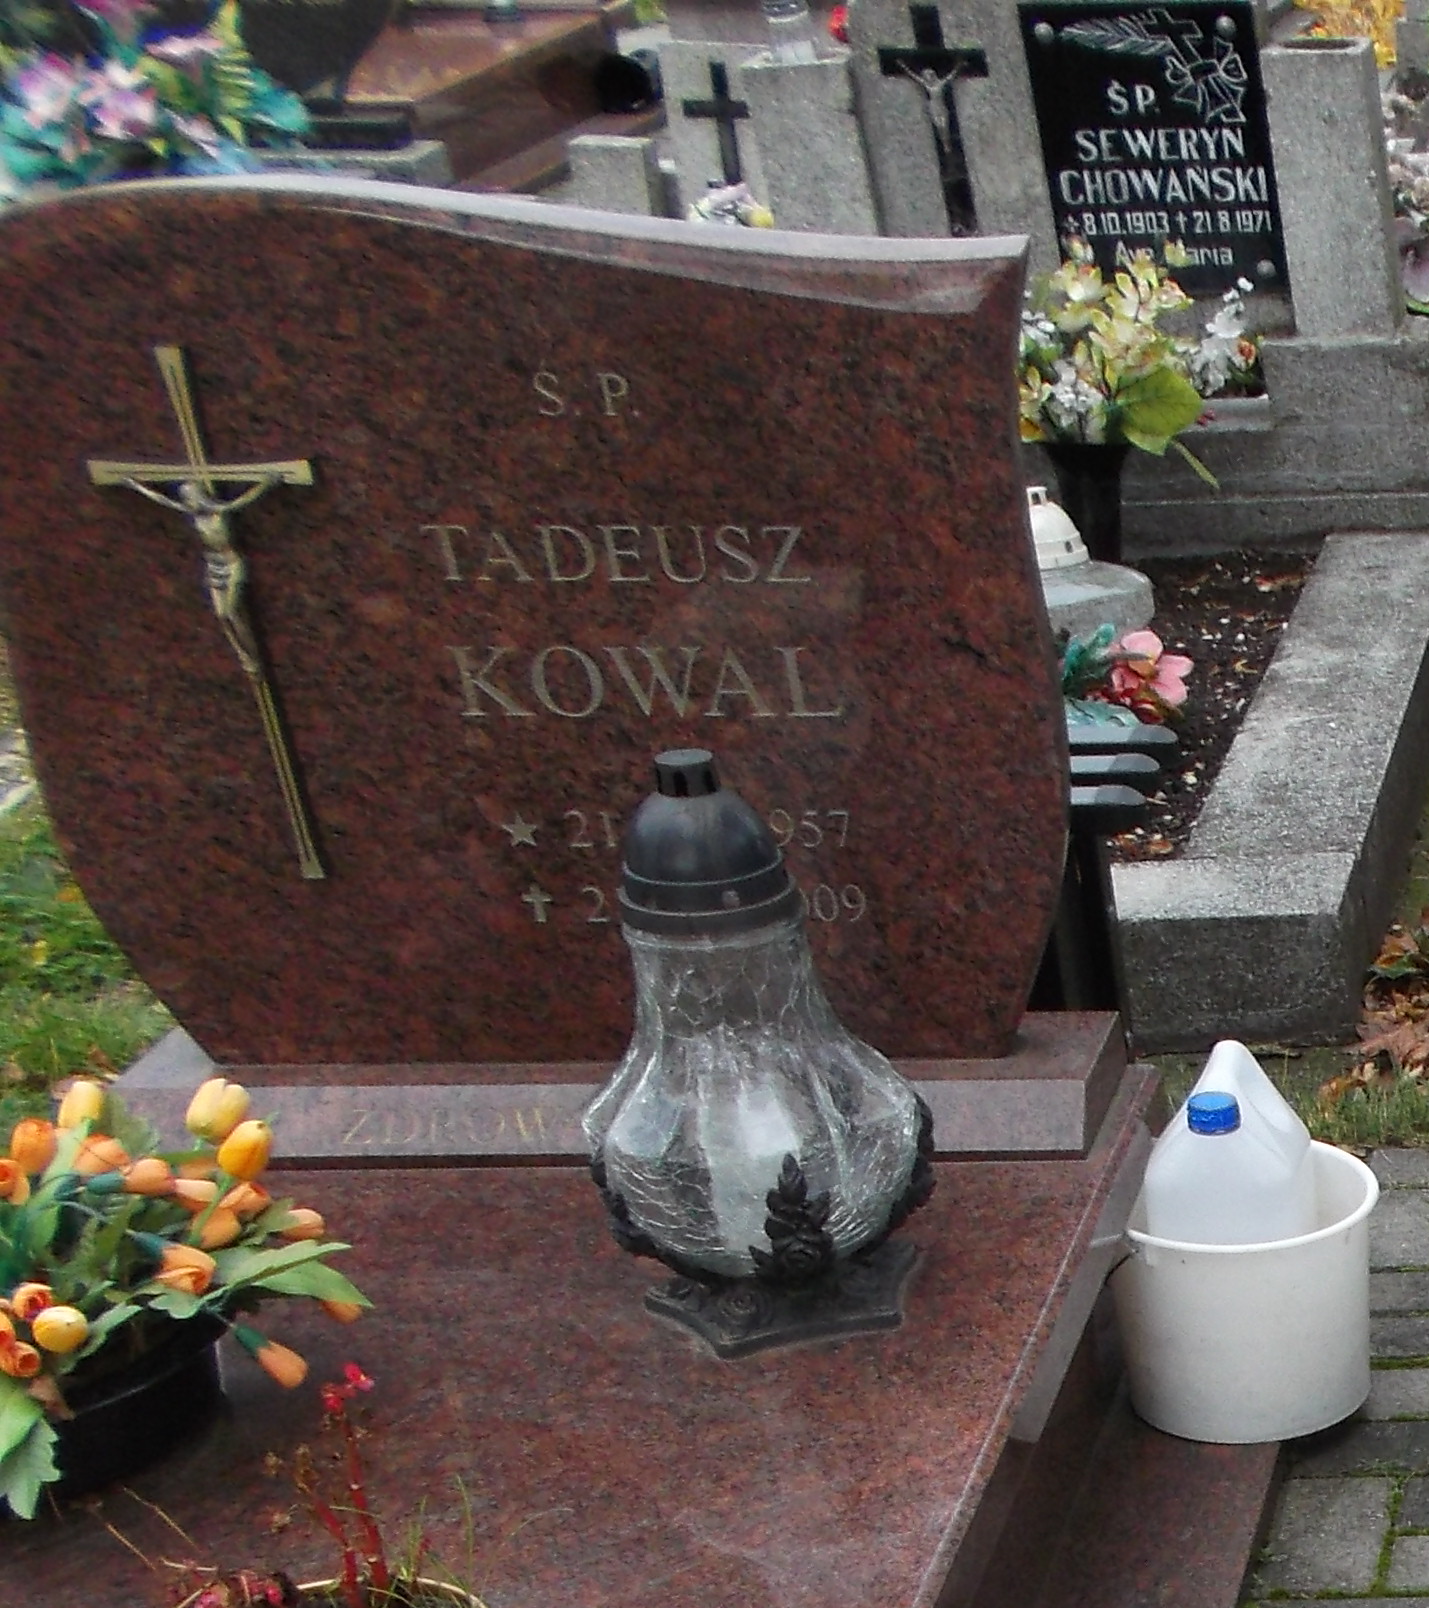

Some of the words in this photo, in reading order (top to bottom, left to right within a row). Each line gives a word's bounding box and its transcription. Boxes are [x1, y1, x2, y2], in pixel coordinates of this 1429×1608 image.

[1074, 128, 1246, 162] SEWERYN
[1058, 164, 1270, 205] CHOWAŃSKI
[419, 524, 812, 584] TADEUSZ
[445, 645, 847, 718] KOWAL
[768, 807, 850, 849] 957
